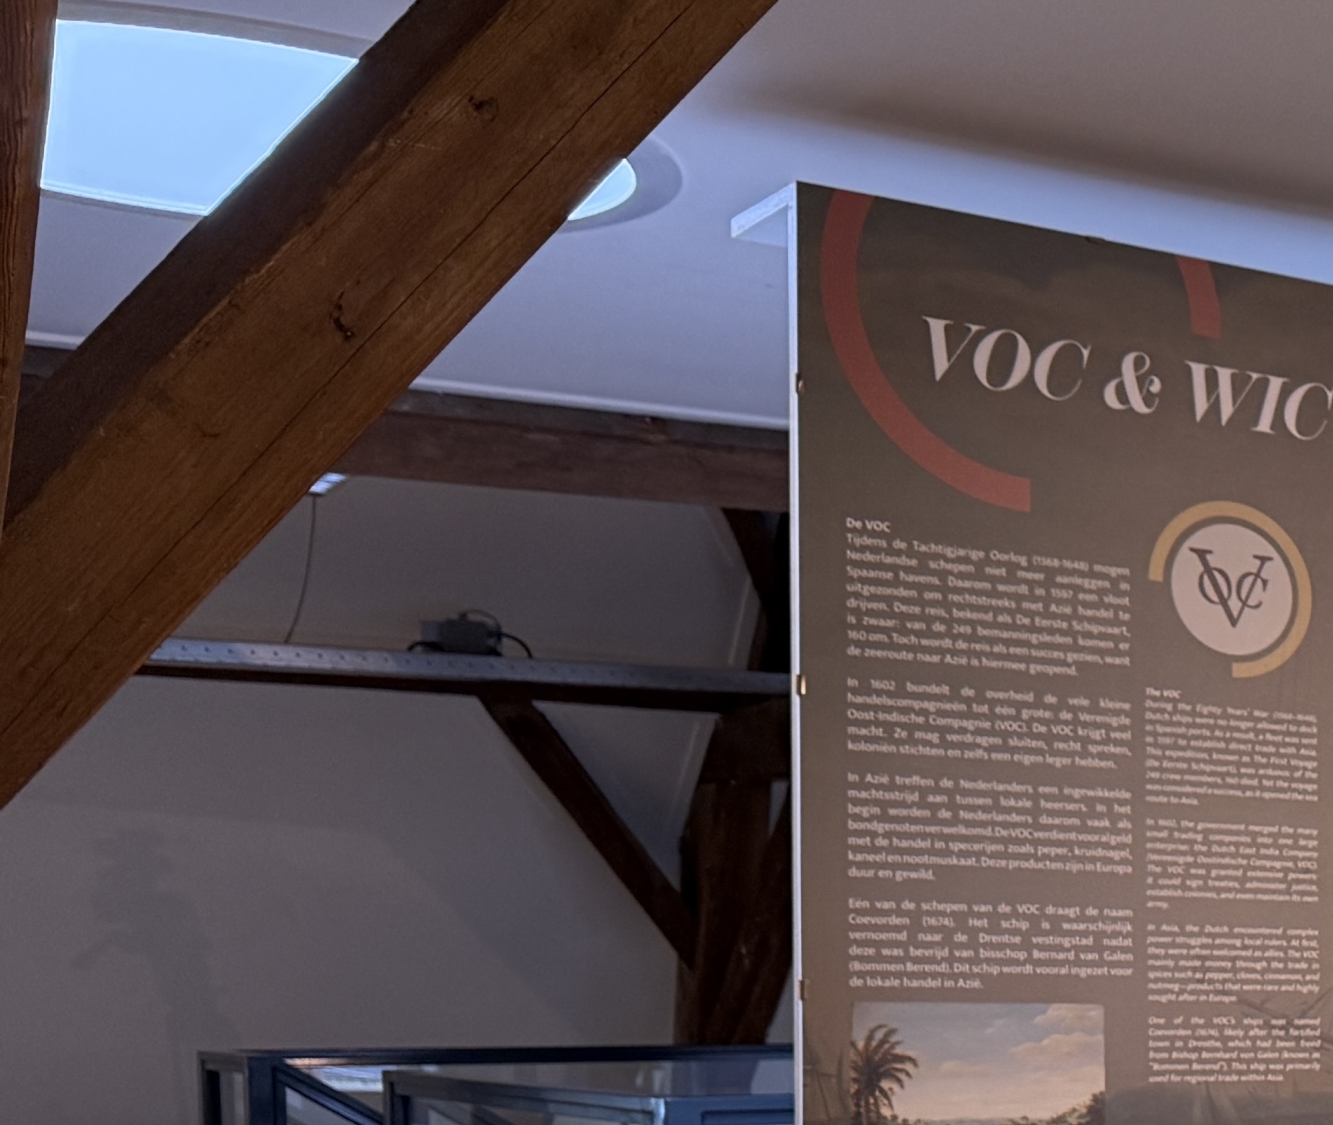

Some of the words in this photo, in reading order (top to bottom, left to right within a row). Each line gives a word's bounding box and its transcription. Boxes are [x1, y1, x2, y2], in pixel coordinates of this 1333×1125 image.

[923, 316, 1091, 401] VOC
[1103, 351, 1162, 414] &
[846, 517, 863, 530] De
[865, 519, 891, 533] VOC
[846, 532, 888, 548] Tijdens
[892, 538, 908, 550] de
[912, 540, 986, 562] Tachtigjarige
[989, 549, 1028, 567] Oorlog
[1093, 564, 1130, 578] mogen
[846, 549, 918, 567] Nederlandse
[928, 559, 975, 574] schepen
[984, 566, 1007, 577] niet
[1016, 570, 1045, 581] meer
[1055, 575, 1111, 590] aanleggen
[1119, 582, 1131, 591] in
[846, 565, 894, 581] Spaanse
[899, 570, 942, 585] havens.
[947, 575, 992, 590] Daarom
[996, 583, 1029, 595] wordt
[1034, 587, 1046, 597] in
[1077, 592, 1099, 602] een
[1102, 593, 1130, 607] vloot
[846, 597, 890, 612] drijven.
[893, 601, 922, 615] Deze
[924, 606, 949, 619] reis,
[952, 607, 994, 622] bekend
[996, 612, 1013, 624] als
[1015, 613, 1031, 626] De
[1034, 616, 1069, 630] Eerste
[1071, 620, 1131, 637] Schipvaart,
[846, 677, 859, 688] In
[870, 678, 896, 691] 1602
[906, 681, 950, 696] bundelt
[960, 686, 976, 698] de
[985, 689, 1034, 703] overheid
[1043, 693, 1058, 705] de
[1067, 696, 1090, 707] vele
[1099, 697, 1131, 711] kleine
[846, 708, 926, 725] Oost-Indische
[928, 714, 992, 731] Compagnie
[994, 720, 1028, 733] (VOC).
[1032, 722, 1048, 734] De
[1050, 724, 1074, 737] VOC
[1109, 730, 1132, 740] veel
[972, 702, 990, 714] tot
[1058, 709, 1073, 721] de
[847, 725, 887, 737] macht.
[893, 726, 908, 739] Ze
[914, 730, 940, 744] mag
[945, 732, 1003, 747] verdragen
[1007, 736, 1048, 750] sluiten,
[1053, 740, 1082, 752] recht
[1087, 743, 1132, 757] spreken,
[847, 835, 872, 847] met
[874, 835, 890, 847] de
[892, 836, 931, 849] handel
[934, 840, 946, 849] in
[948, 841, 1005, 855] specerijen
[1007, 843, 1035, 854] zoals
[1037, 845, 1072, 858] peper,
[1073, 845, 1133, 861] kruidnagel,
[848, 913, 911, 926] Coevorden
[922, 916, 955, 928] (1674).
[968, 917, 988, 928] Het
[1000, 918, 1030, 932] schip
[1041, 920, 1051, 930] is
[1061, 920, 1133, 935] waarschijnlijk
[874, 901, 897, 910] van
[900, 899, 916, 910] de
[920, 900, 968, 914] schepen
[972, 904, 993, 913] van
[997, 902, 1012, 914] de
[1016, 903, 1040, 915] VOC
[1044, 904, 1081, 919] draagt
[1085, 906, 1099, 917] de
[1103, 908, 1134, 917] naam
[848, 975, 864, 987] de
[866, 976, 901, 987] lokale
[902, 976, 942, 988] handel
[943, 979, 955, 988] in
